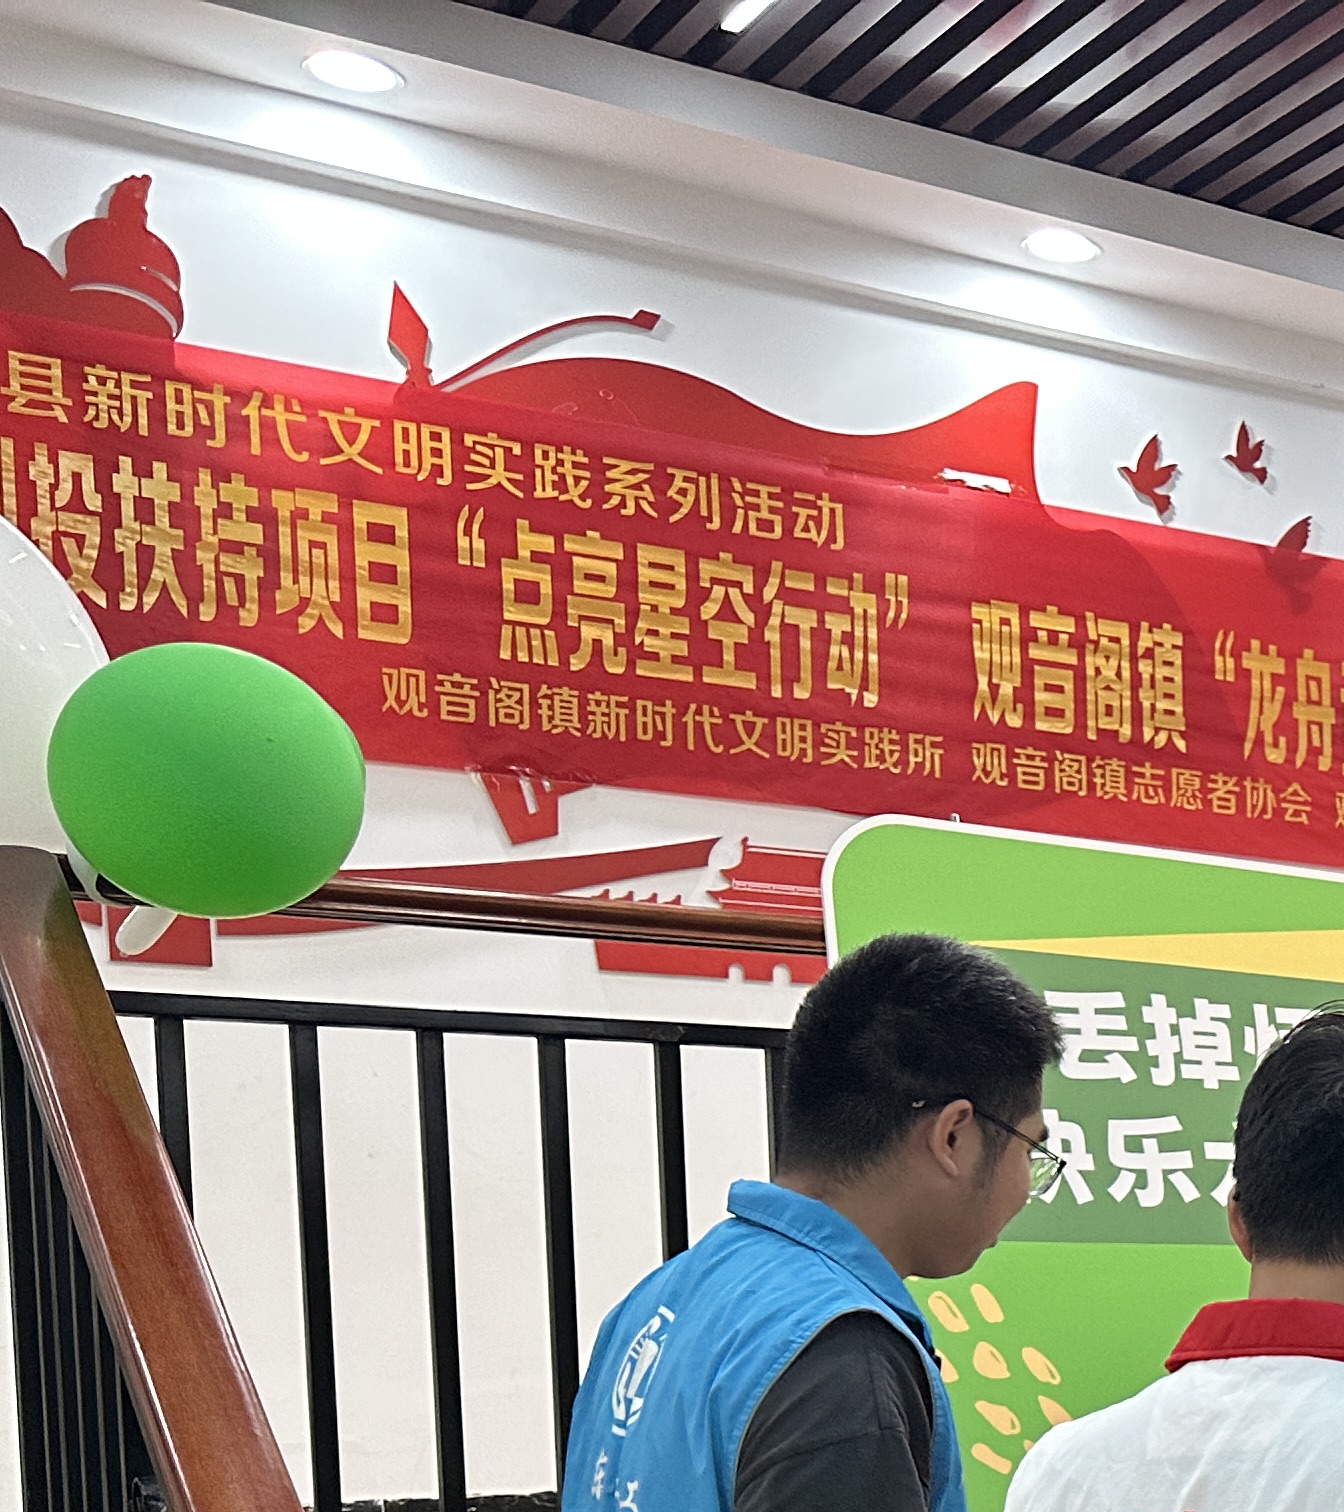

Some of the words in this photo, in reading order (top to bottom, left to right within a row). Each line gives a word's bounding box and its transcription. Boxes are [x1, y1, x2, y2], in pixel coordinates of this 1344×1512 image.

[0, 350, 846, 551] 县新时代文明实践系列活动
[0, 436, 910, 709] 投扶持项目“点亮星空行动”
[381, 667, 944, 779] 观音阁镇新时代文明实践所
[971, 743, 1313, 825] 观音阁镇志愿者协会
